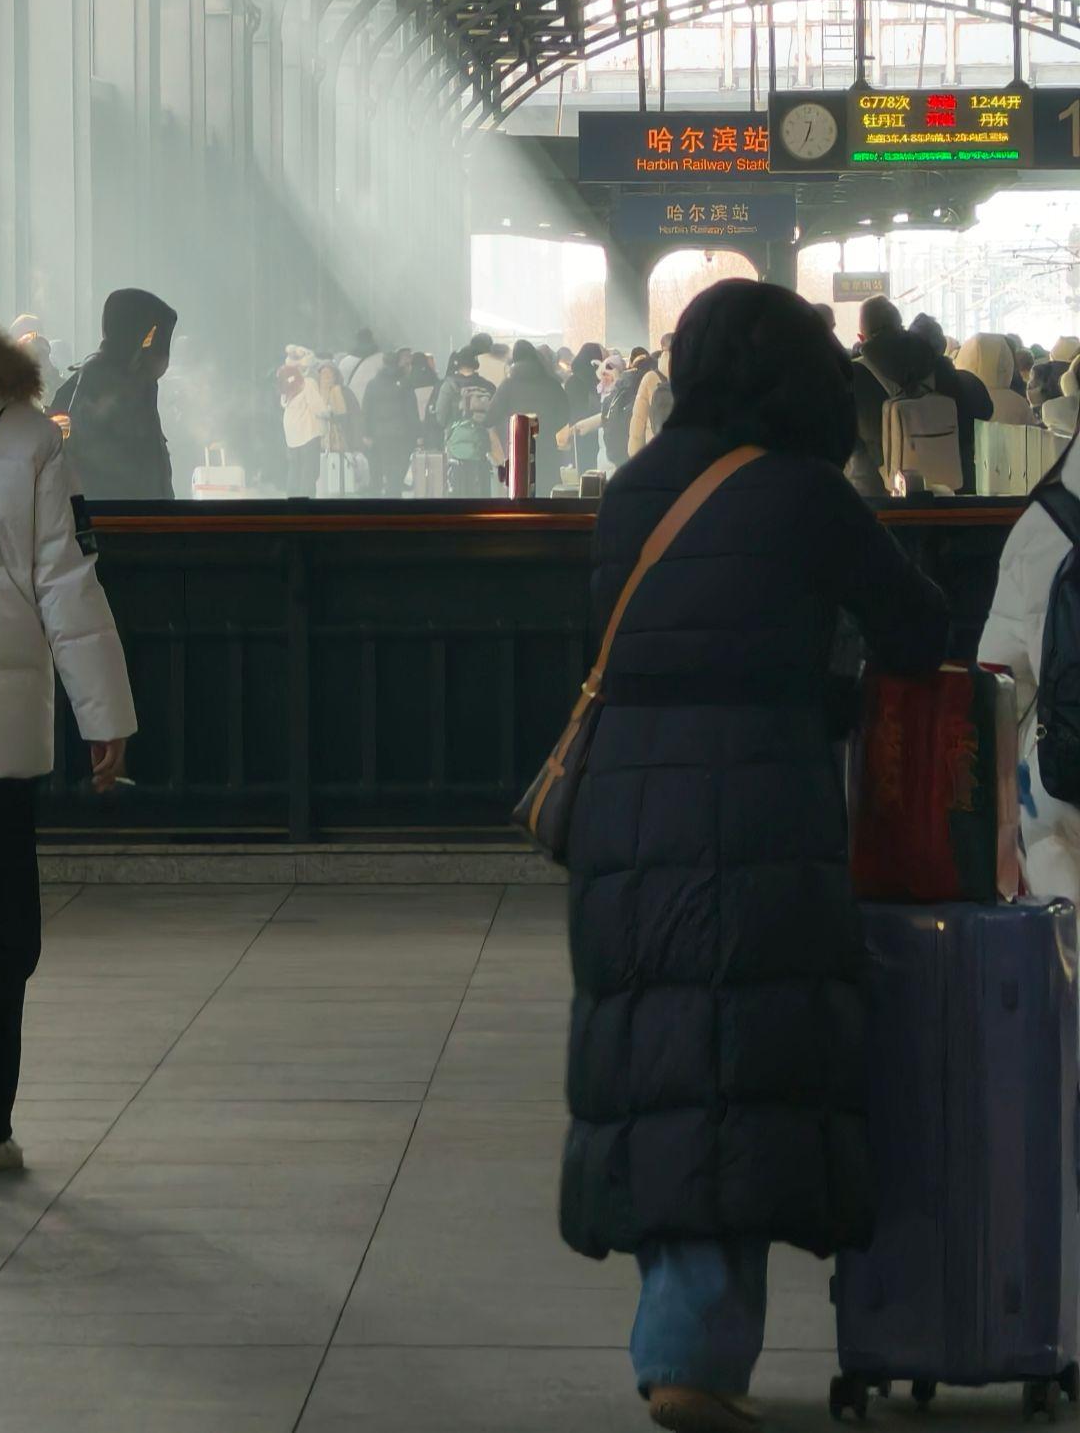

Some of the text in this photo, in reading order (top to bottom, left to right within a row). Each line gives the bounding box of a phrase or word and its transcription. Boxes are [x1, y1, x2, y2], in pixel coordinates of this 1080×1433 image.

[860, 95, 910, 110] G778次
[970, 95, 1021, 109] 12:44开
[863, 114, 905, 128] 牡丹江
[978, 112, 1009, 127] 丹东
[648, 126, 769, 153] 哈尔滨站
[636, 158, 679, 172] Harbin
[683, 158, 732, 173] Railway
[666, 203, 749, 222] 哈尔滨站
